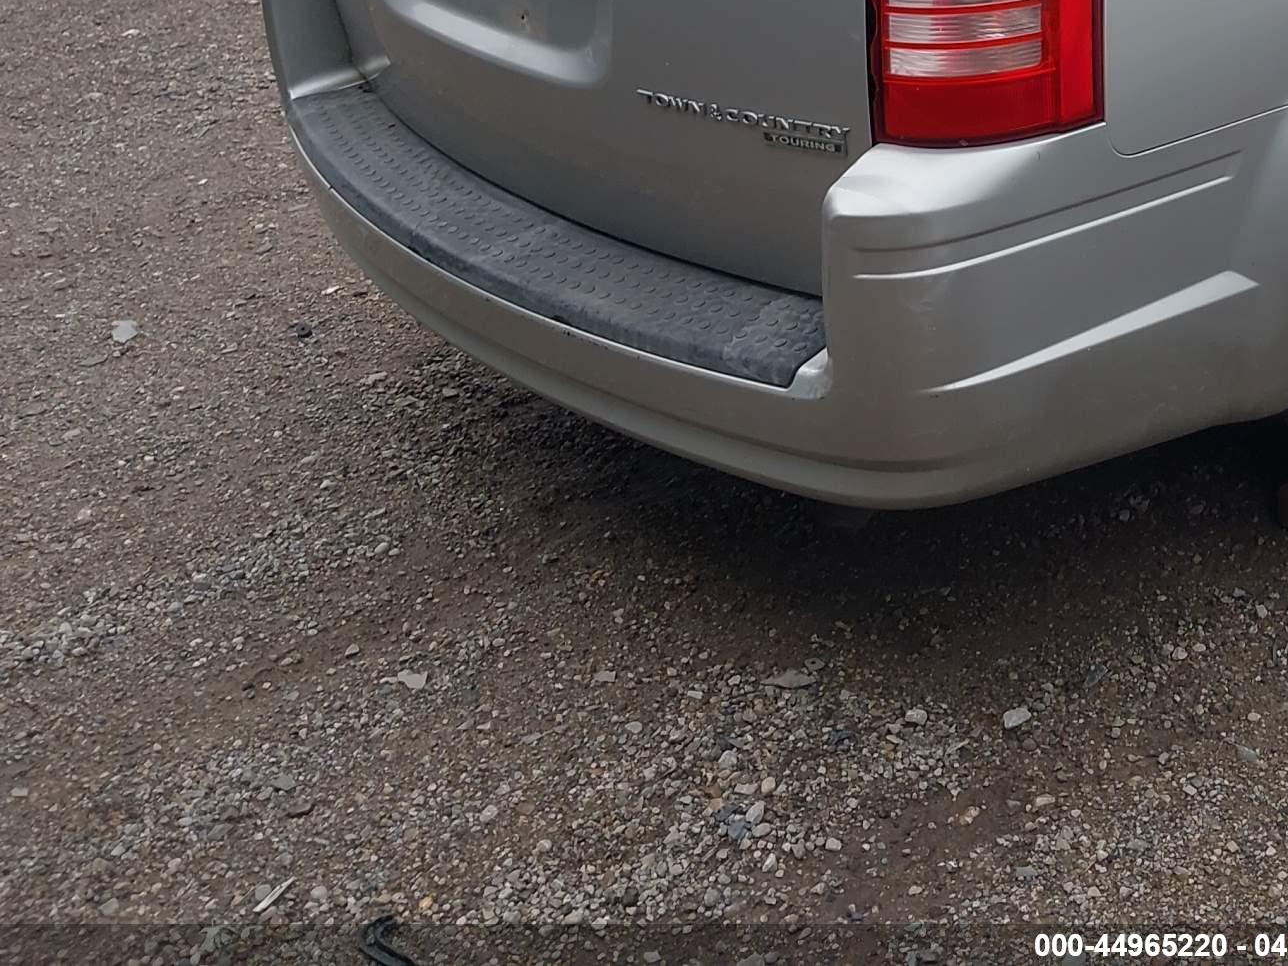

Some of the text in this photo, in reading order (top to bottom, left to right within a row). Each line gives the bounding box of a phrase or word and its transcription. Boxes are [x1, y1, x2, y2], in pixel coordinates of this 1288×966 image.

[636, 88, 704, 114] TOWN
[725, 108, 849, 139] COUNTRY
[769, 134, 837, 153] TOURING
